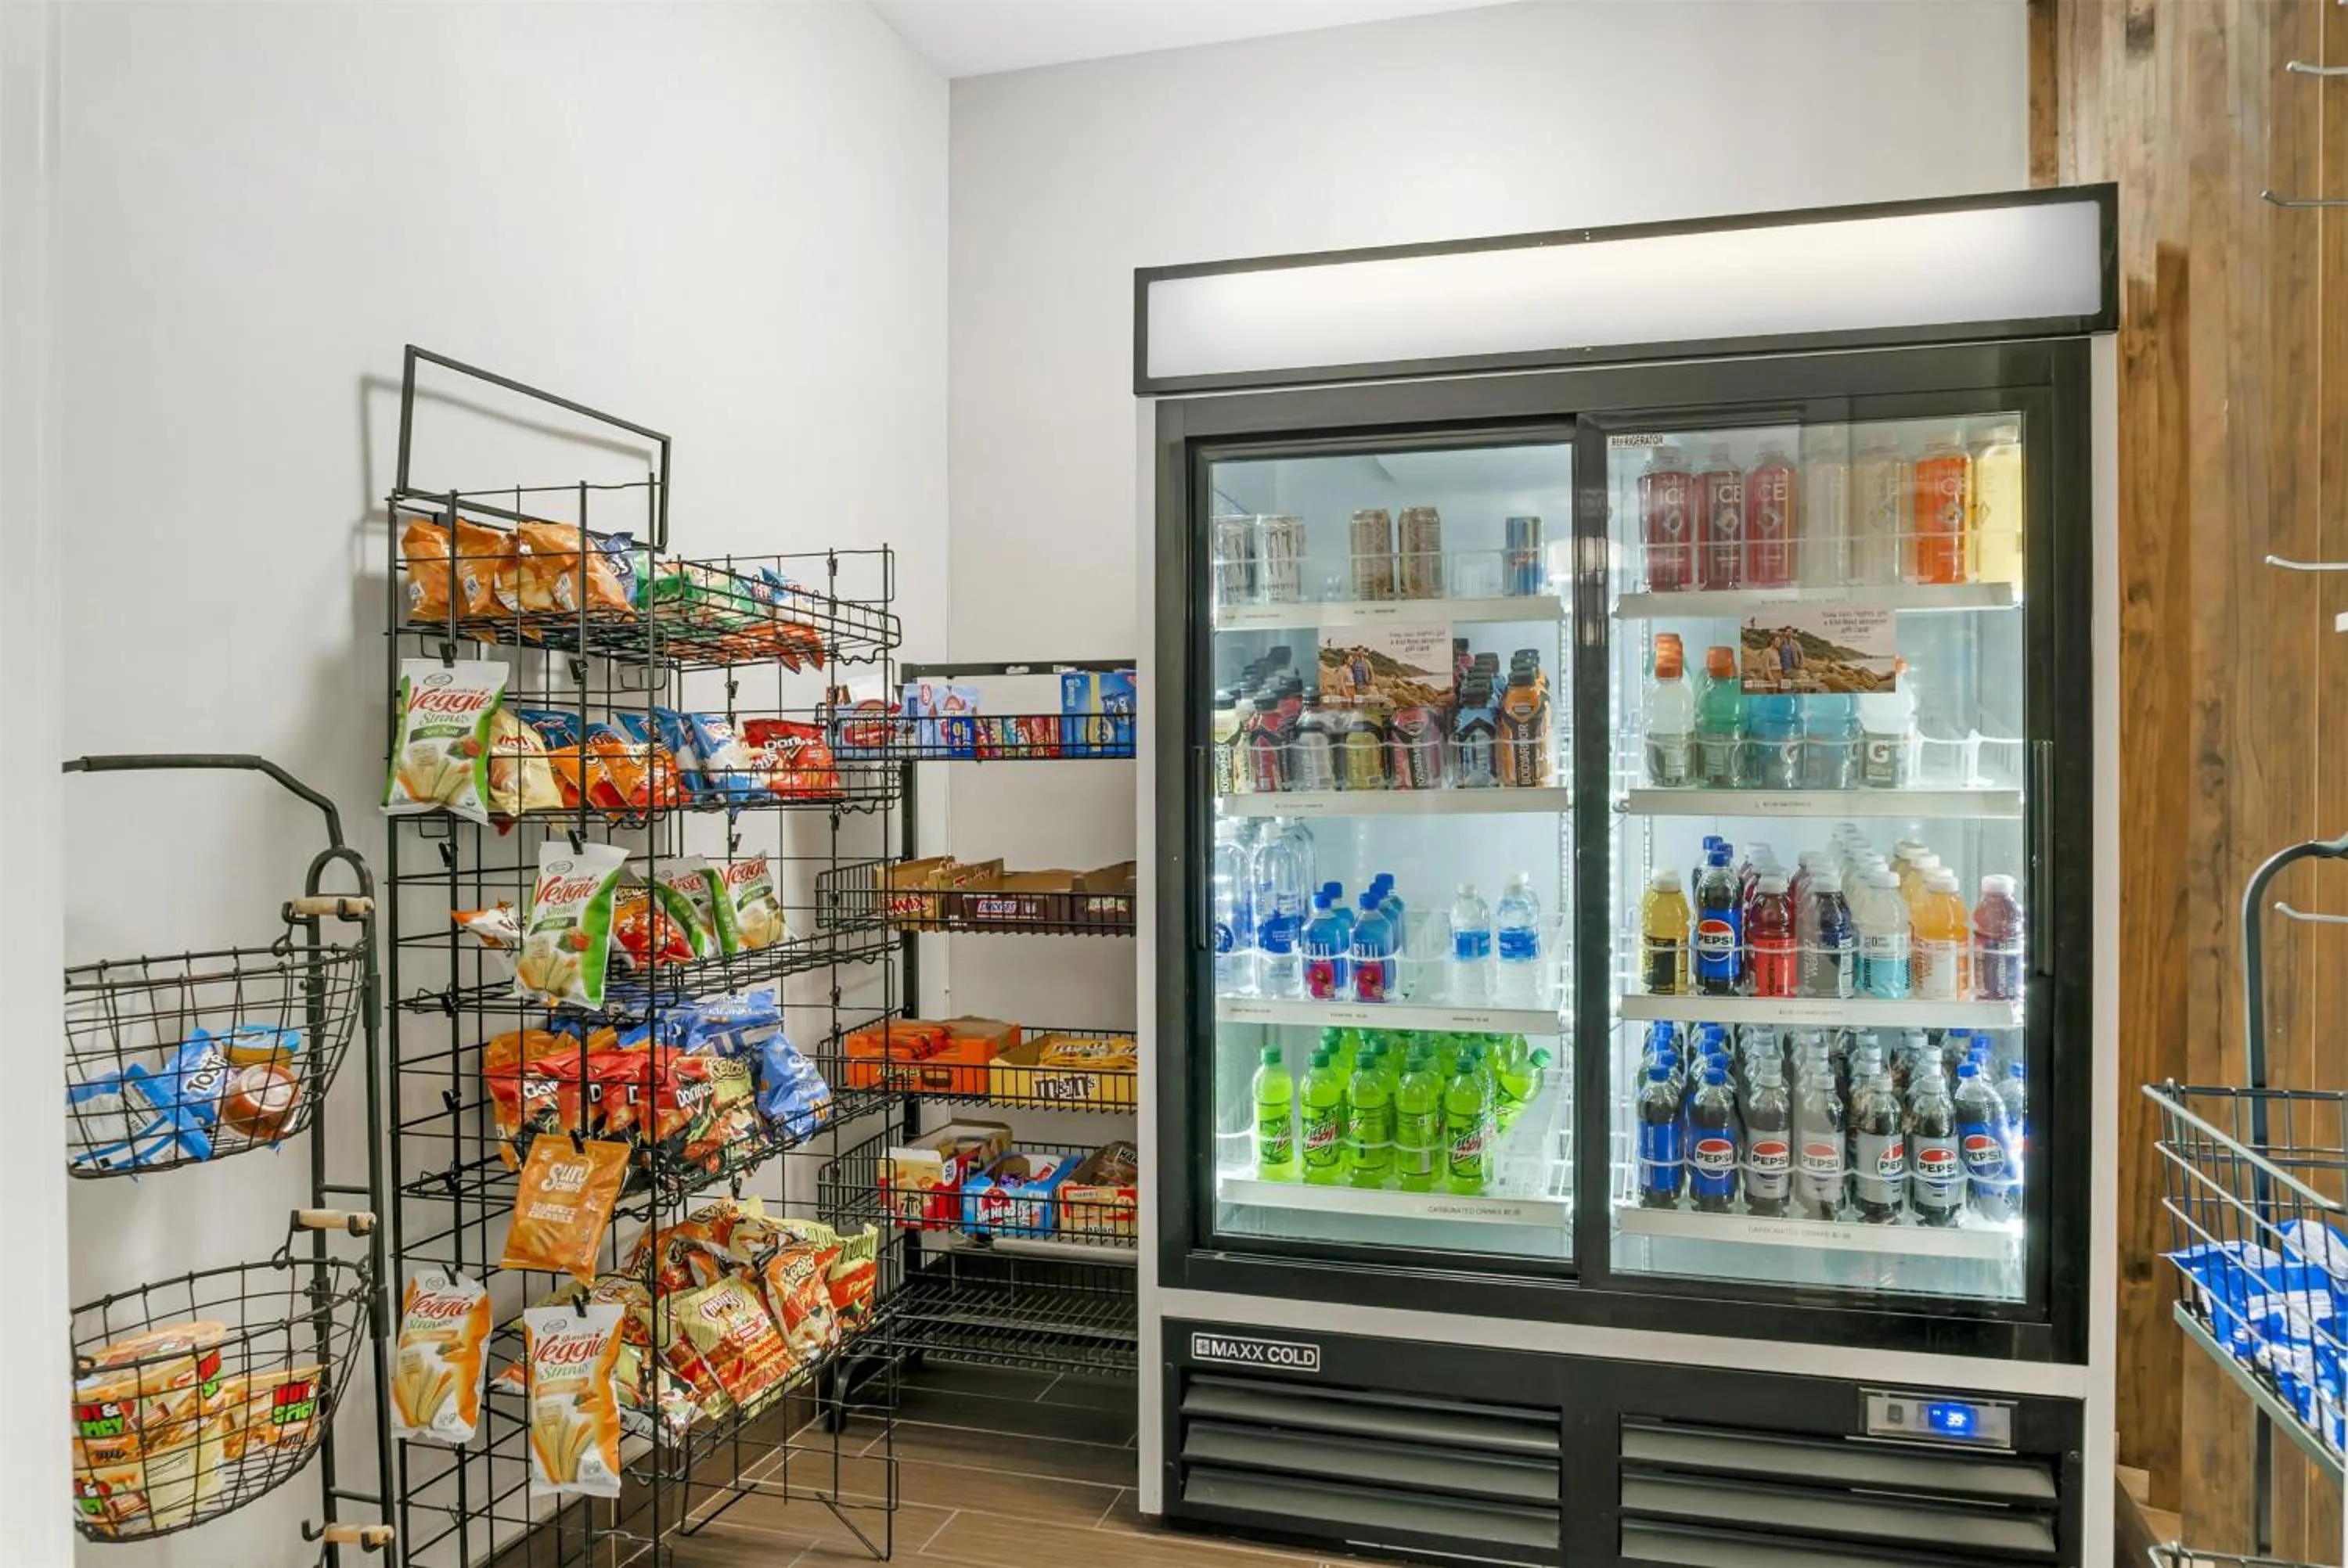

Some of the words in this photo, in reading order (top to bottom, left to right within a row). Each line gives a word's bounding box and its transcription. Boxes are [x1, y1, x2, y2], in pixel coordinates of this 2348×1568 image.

[1612, 435, 1663, 447] REFRIGERATOR
[408, 685, 492, 714] Veggie
[1868, 739, 1889, 764] G
[535, 876, 600, 905] Veggie
[1698, 935, 1734, 946] PEPSI
[1695, 1151, 1733, 1163] PEPSI
[1752, 1153, 1789, 1165] PEPSI
[1802, 1156, 1838, 1169] PEPSI
[1965, 1150, 2002, 1162] PEPSI
[405, 1290, 474, 1320] Veggie
[533, 1334, 608, 1365] Veggie
[1212, 1340, 1265, 1361] MAXX
[1267, 1347, 1316, 1366] COLD
